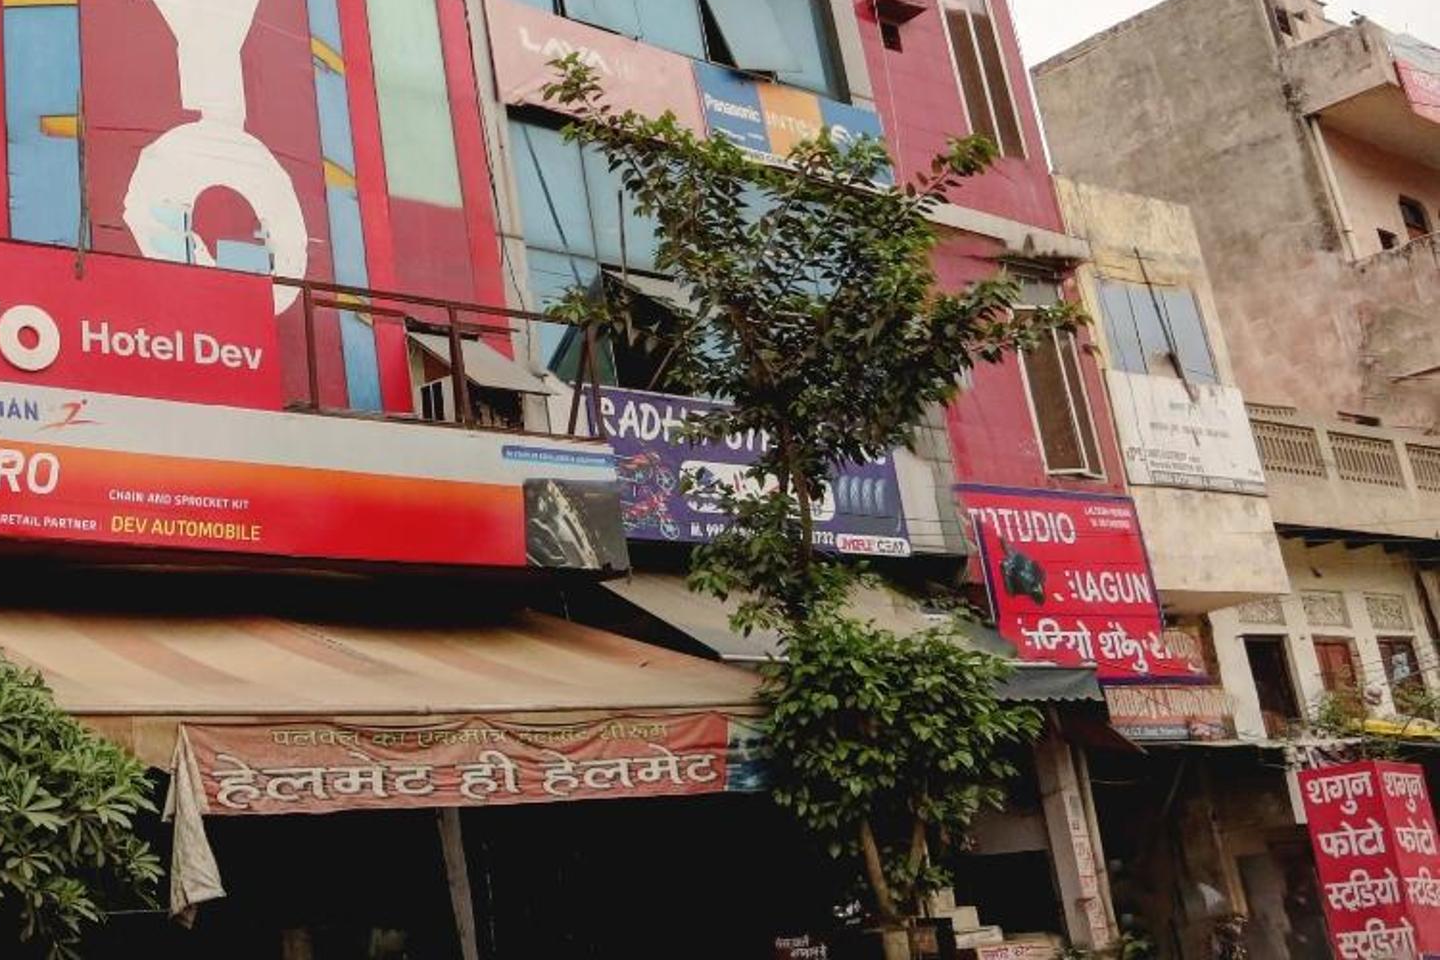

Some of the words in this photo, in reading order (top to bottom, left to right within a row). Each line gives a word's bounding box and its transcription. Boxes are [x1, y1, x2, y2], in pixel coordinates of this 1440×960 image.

[703, 92, 760, 123] Panasonic
[81, 320, 184, 363] Hotel
[194, 333, 263, 371] Dev
[109, 489, 144, 503] CHAIN
[147, 494, 171, 504] AND
[174, 495, 229, 508] SPROCKET
[232, 500, 249, 509] KIT
[0, 513, 41, 527] RETAIL
[43, 518, 97, 530] PARTNER
[111, 516, 148, 534] DEV
[151, 520, 262, 541] AUTOMOBILE
[212, 751, 434, 809] हेलमेट
[456, 750, 520, 800] ही
[542, 742, 718, 796] हेलमेट
[1307, 771, 1374, 815] शगुन
[1383, 771, 1425, 814] शगुन
[1318, 817, 1386, 859] फोटो
[1395, 817, 1438, 856] फोटो
